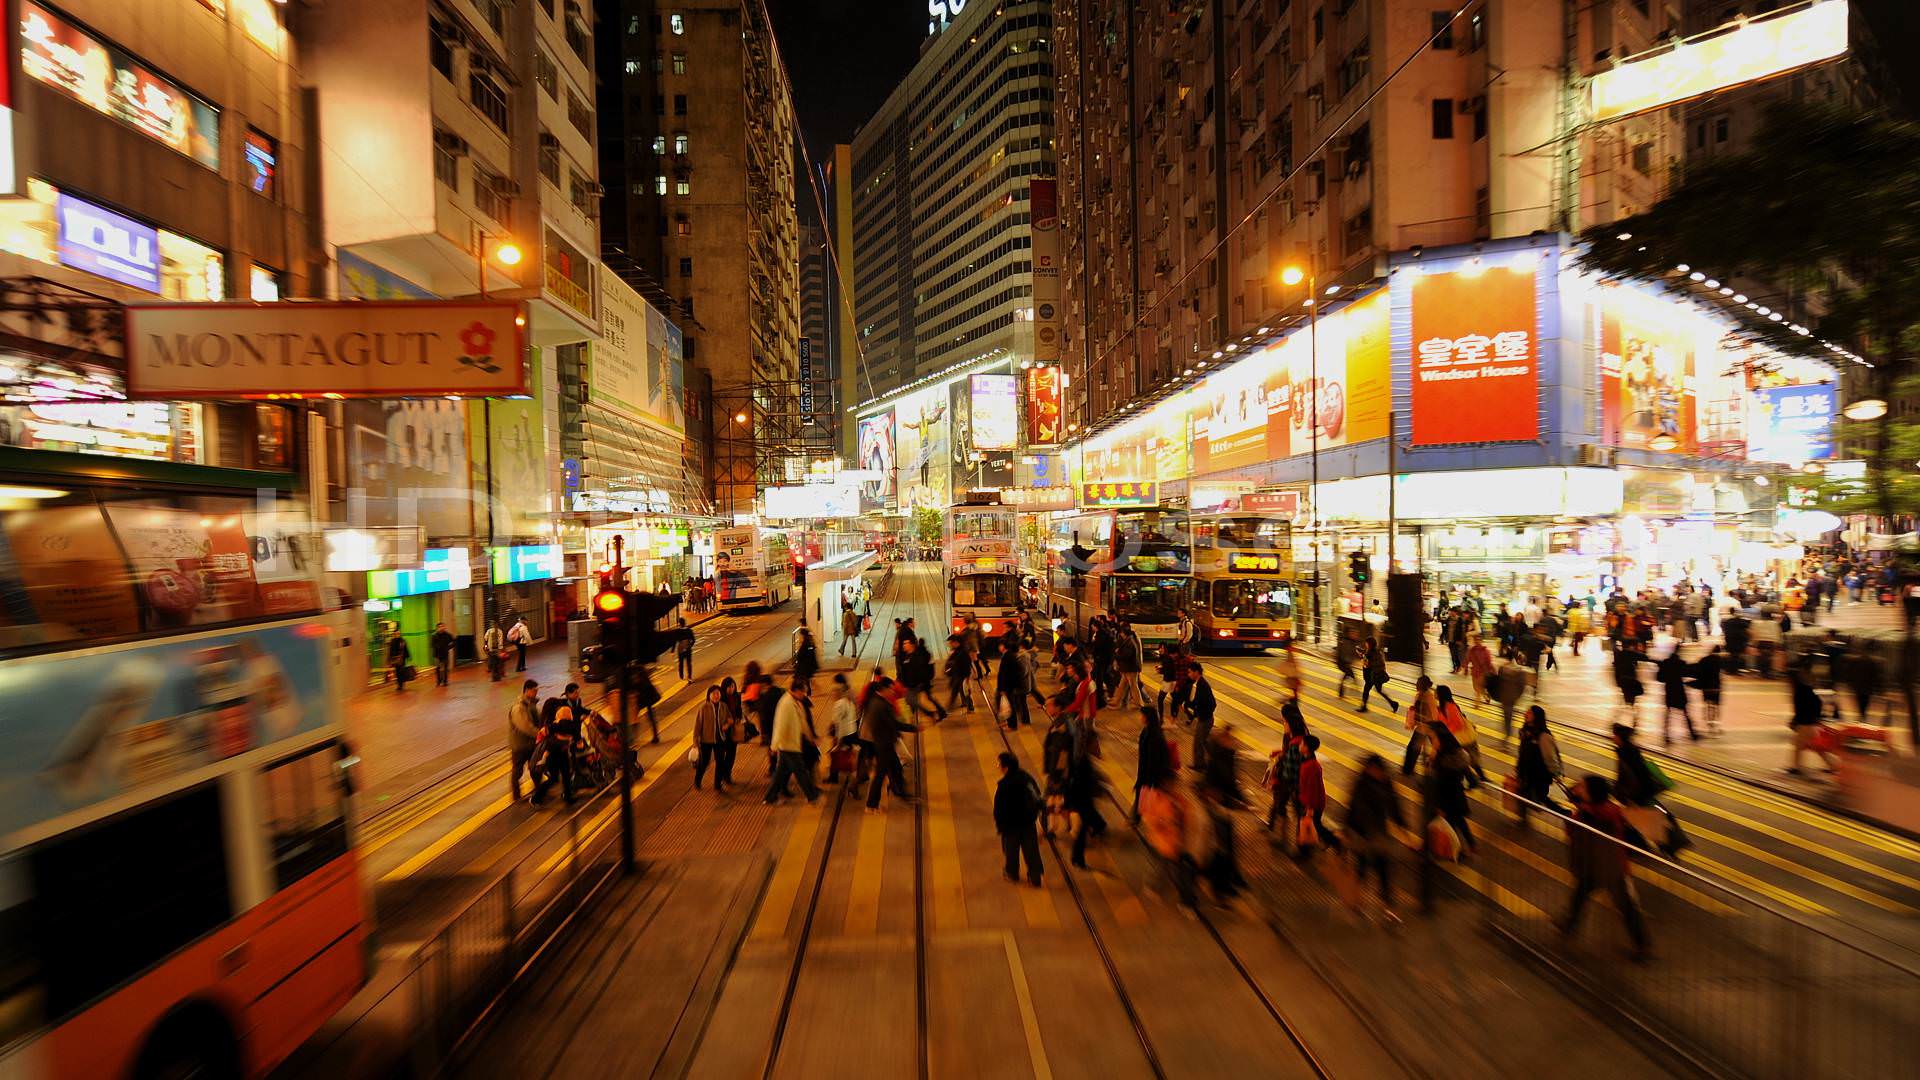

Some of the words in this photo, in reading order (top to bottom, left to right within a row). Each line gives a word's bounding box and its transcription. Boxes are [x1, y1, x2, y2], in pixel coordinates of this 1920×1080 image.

[147, 330, 441, 370] MONTAGUT
[1418, 331, 1530, 368] 皇室堡
[1419, 368, 1480, 382] Windsor
[1481, 366, 1529, 378] House
[973, 493, 993, 501] 162
